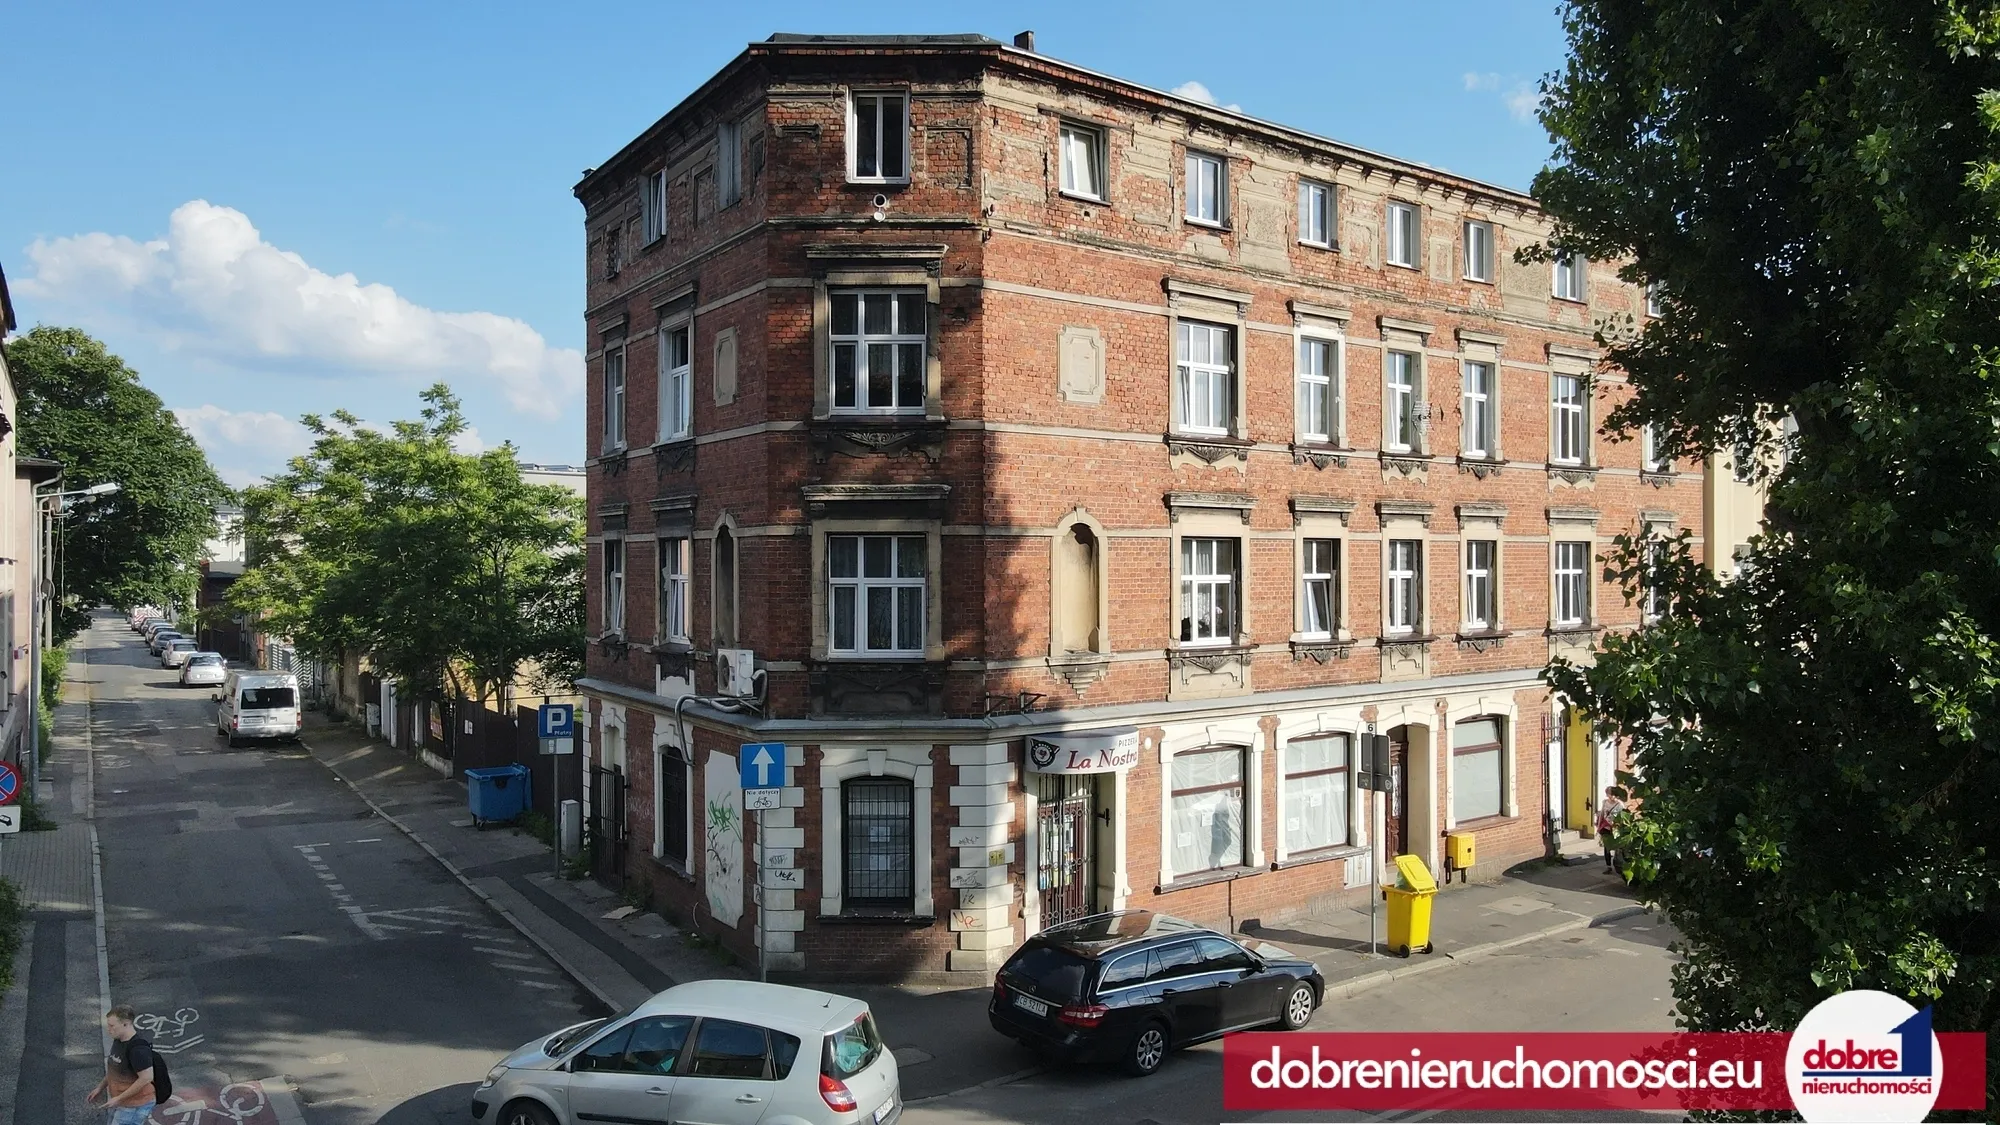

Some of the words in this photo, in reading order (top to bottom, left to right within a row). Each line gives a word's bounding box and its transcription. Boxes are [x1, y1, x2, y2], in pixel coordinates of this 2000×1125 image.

[546, 708, 566, 734] P
[1367, 723, 1374, 732] 6
[1065, 750, 1091, 770] La
